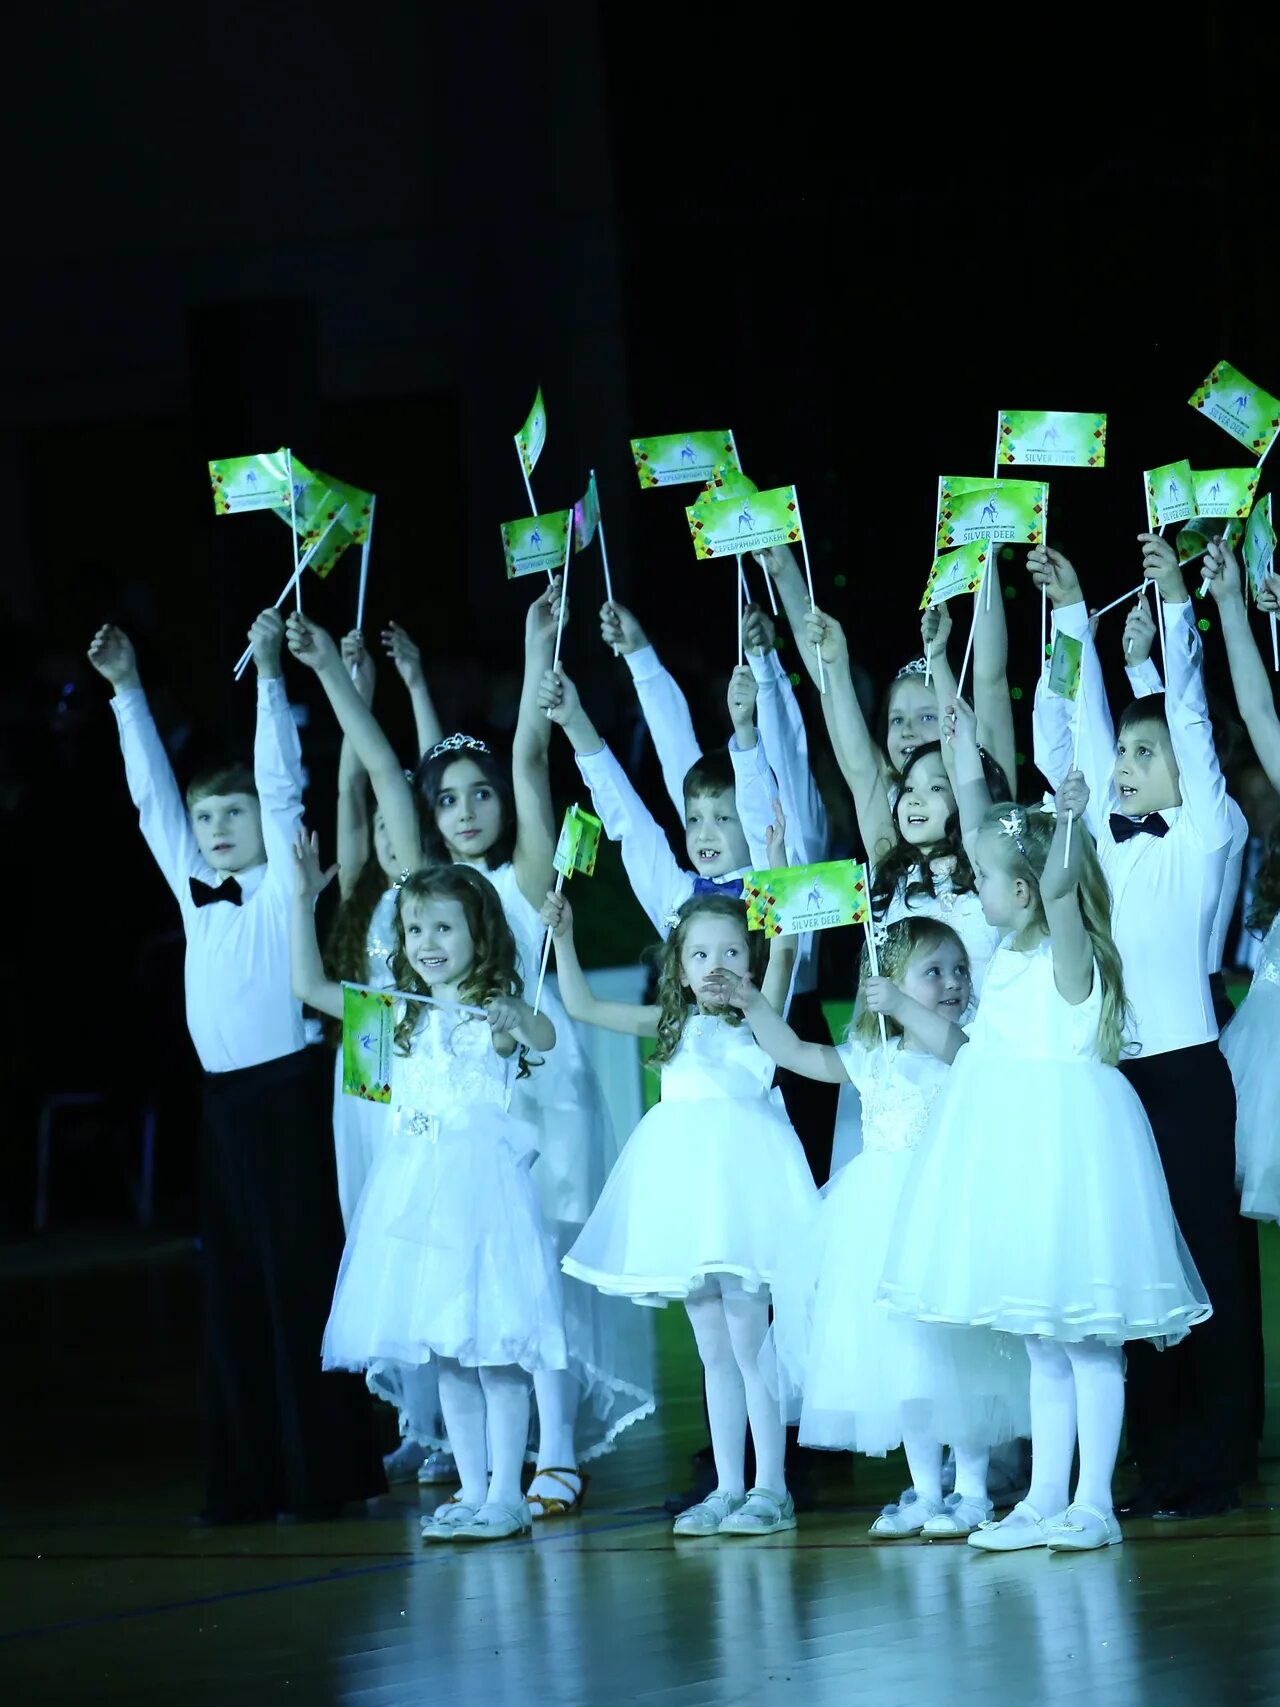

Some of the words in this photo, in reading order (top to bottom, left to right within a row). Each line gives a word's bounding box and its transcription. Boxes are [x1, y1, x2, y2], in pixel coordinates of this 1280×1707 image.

[1025, 453, 1051, 463] SILVER
[963, 530, 991, 541] SILVER
[993, 530, 1015, 540] DEER
[714, 538, 761, 554] СЕРЕБРЯНЫЙ
[762, 532, 788, 545] ОЛЕНЬ
[792, 918, 819, 931] SILVER
[821, 914, 841, 926] DEER
